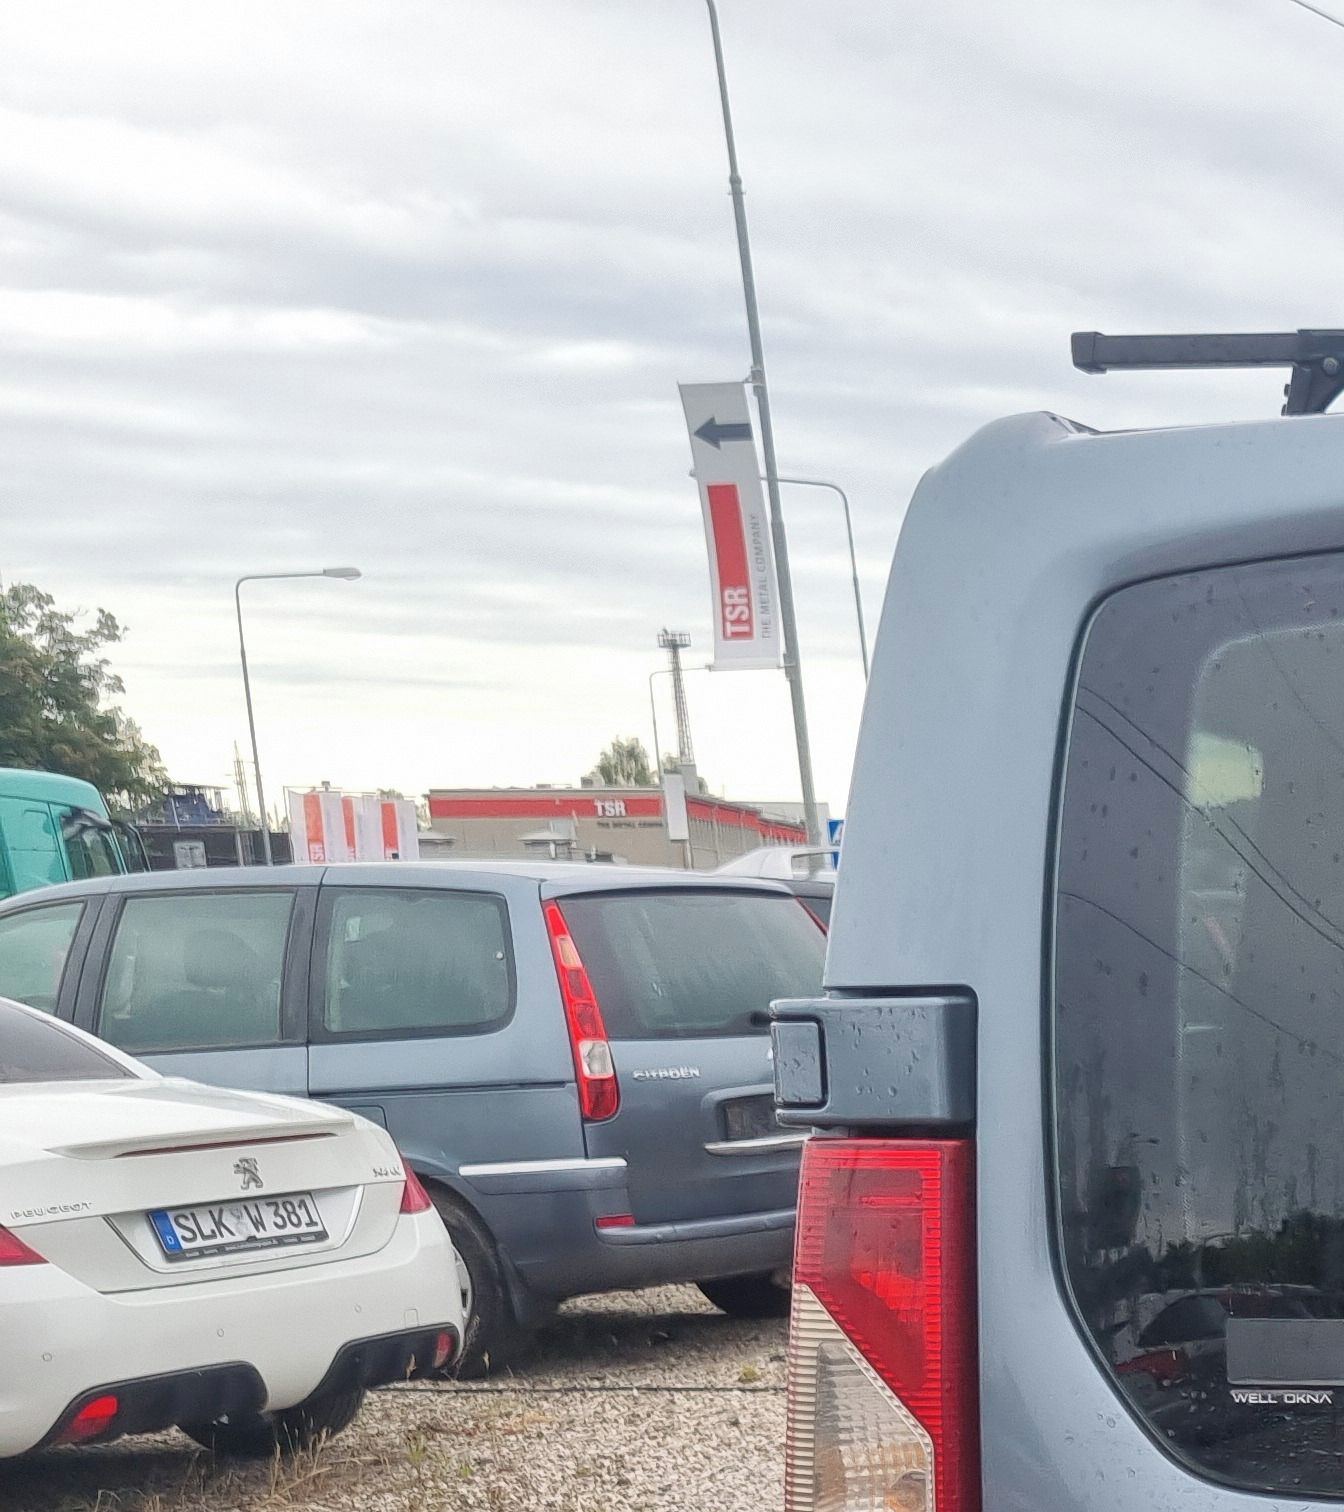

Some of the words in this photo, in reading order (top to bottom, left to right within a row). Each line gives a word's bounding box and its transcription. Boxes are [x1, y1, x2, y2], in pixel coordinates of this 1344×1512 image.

[750, 514, 766, 572] COMPANY
[723, 586, 750, 639] TSR
[759, 579, 770, 615] METAL
[594, 799, 627, 817] TSR
[166, 1234, 175, 1245] D
[173, 1207, 236, 1244] SLK
[243, 1203, 268, 1234] W
[266, 1199, 319, 1231] 381
[1231, 1392, 1278, 1404] WELL
[1283, 1392, 1333, 1404] OKNA
